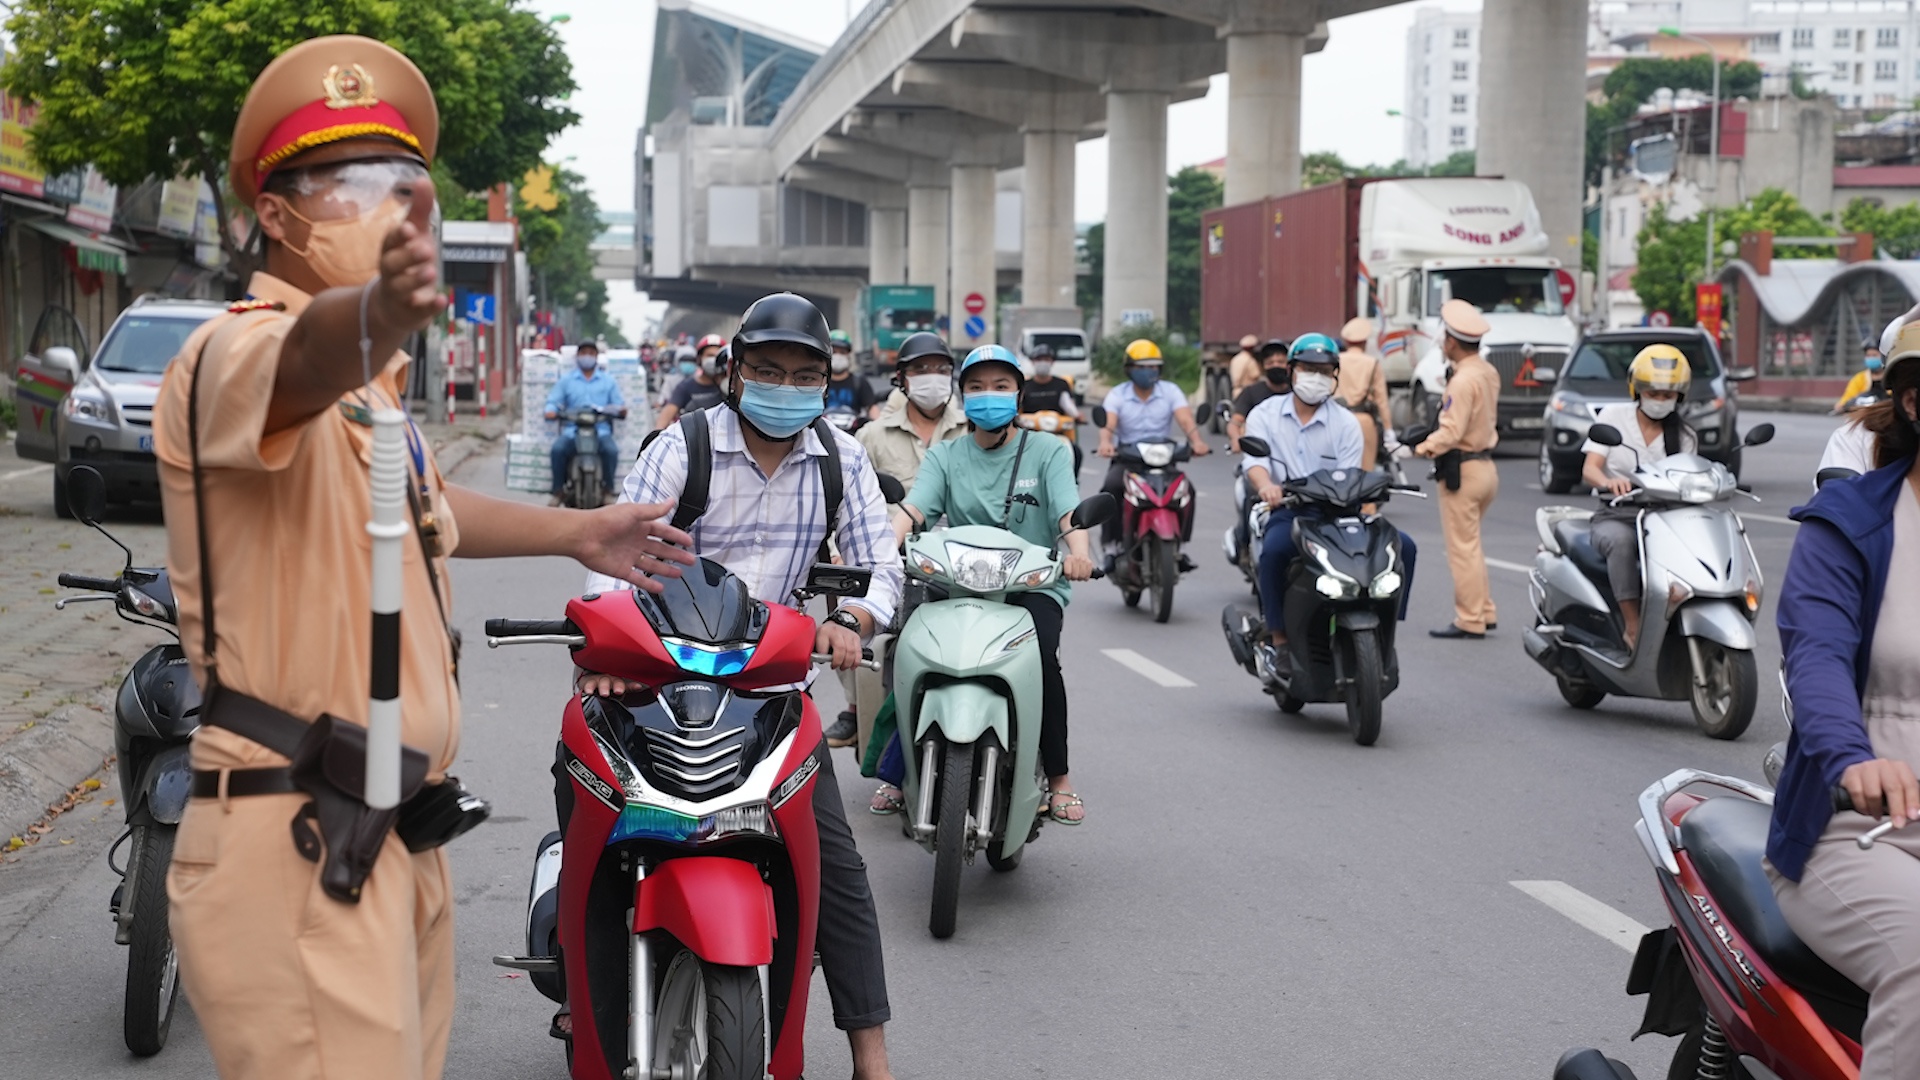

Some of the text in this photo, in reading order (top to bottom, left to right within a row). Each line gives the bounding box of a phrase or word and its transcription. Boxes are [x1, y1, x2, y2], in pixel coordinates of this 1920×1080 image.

[1443, 222, 1493, 246] SONG
[675, 684, 713, 693] HONDA
[575, 764, 614, 799] AMG
[1692, 894, 1719, 926] AIR
